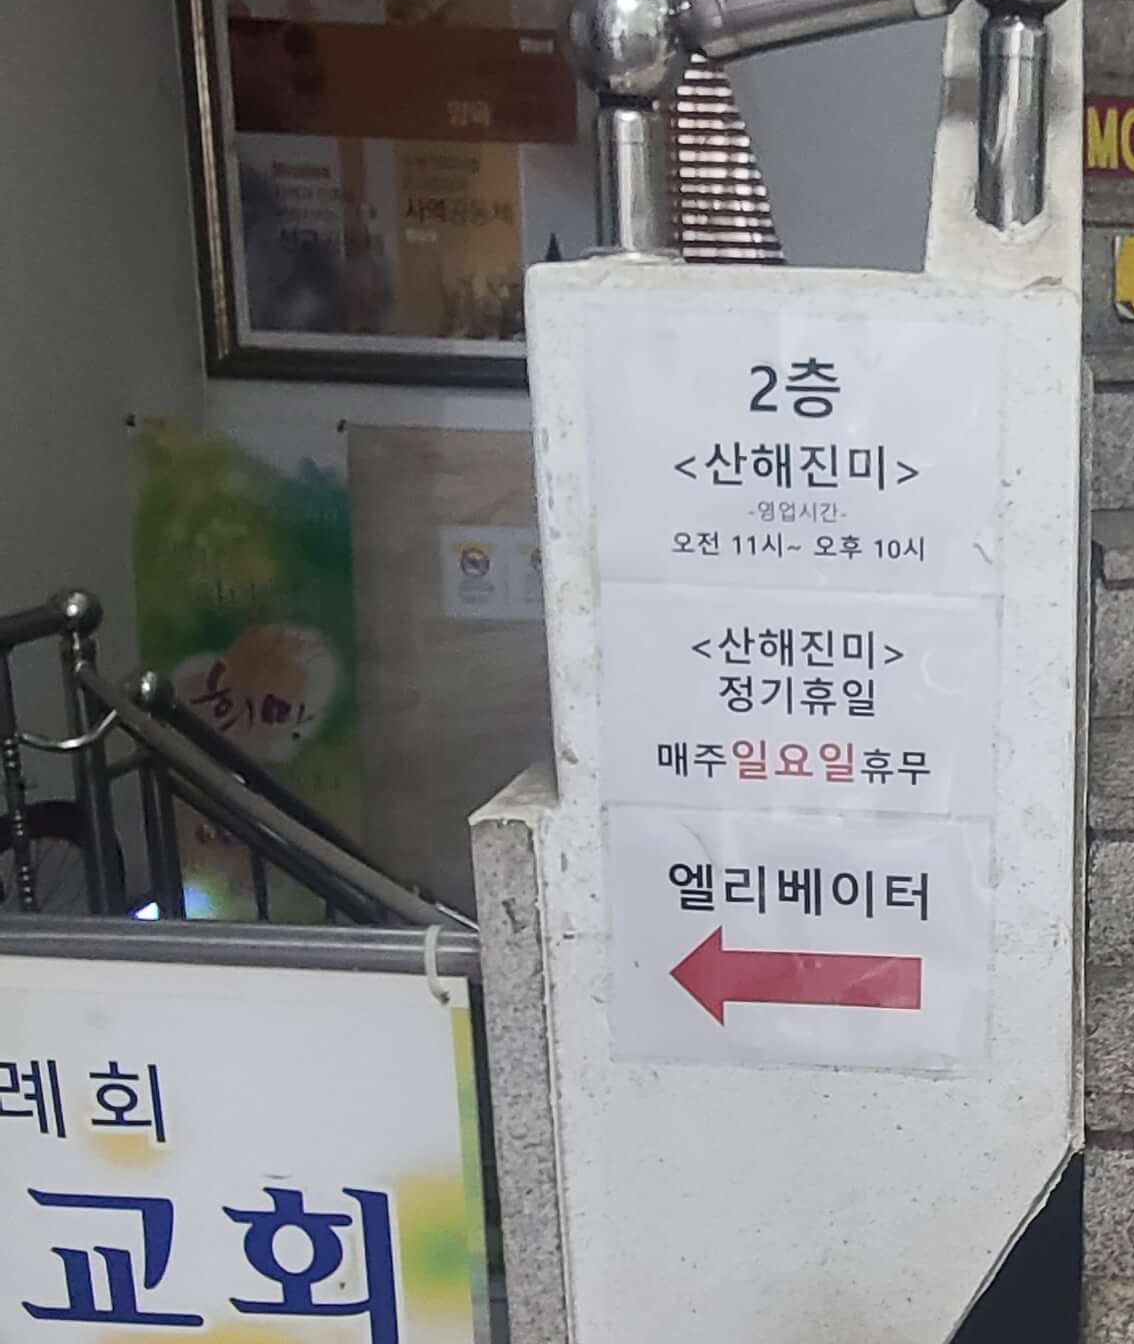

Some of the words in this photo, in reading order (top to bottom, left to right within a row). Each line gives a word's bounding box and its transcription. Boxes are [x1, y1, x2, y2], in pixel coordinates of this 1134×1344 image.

[749, 358, 842, 420] 2층
[674, 442, 921, 493] <산해진미>
[748, 501, 848, 525] -영업시간-
[672, 532, 719, 558] 오전
[733, 534, 802, 560] 11시~
[814, 535, 862, 561] 오후
[875, 537, 926, 562] 10시
[691, 628, 905, 671] <산해진미>
[718, 676, 877, 719] 정기휴일
[657, 740, 932, 787] 매주일요일휴무
[668, 863, 931, 922] 엘리베이터
